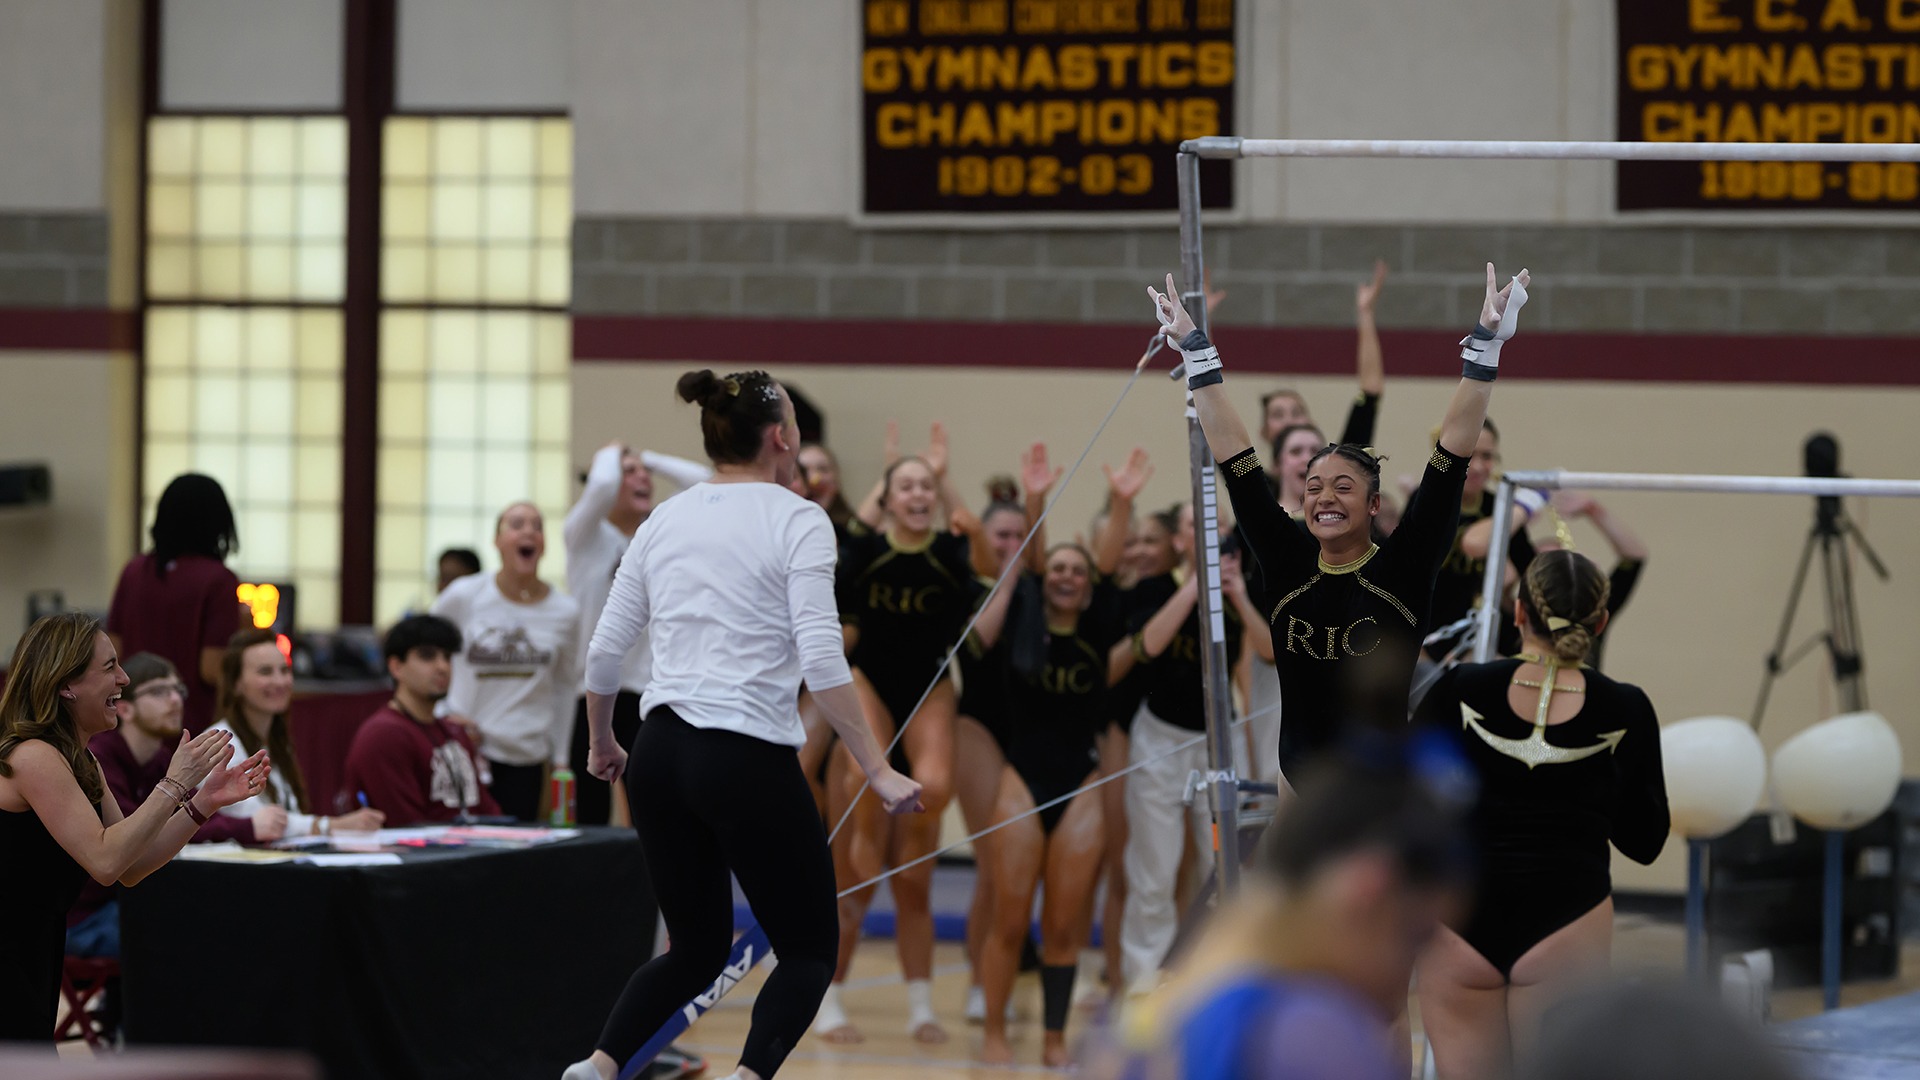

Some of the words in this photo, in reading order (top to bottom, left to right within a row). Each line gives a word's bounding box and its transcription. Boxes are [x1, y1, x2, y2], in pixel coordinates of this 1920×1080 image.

[863, 41, 1234, 92] GYMNASTICS
[876, 98, 1221, 148] CHAMPIONS
[869, 582, 943, 613] RIC
[1286, 614, 1382, 661] RIC
